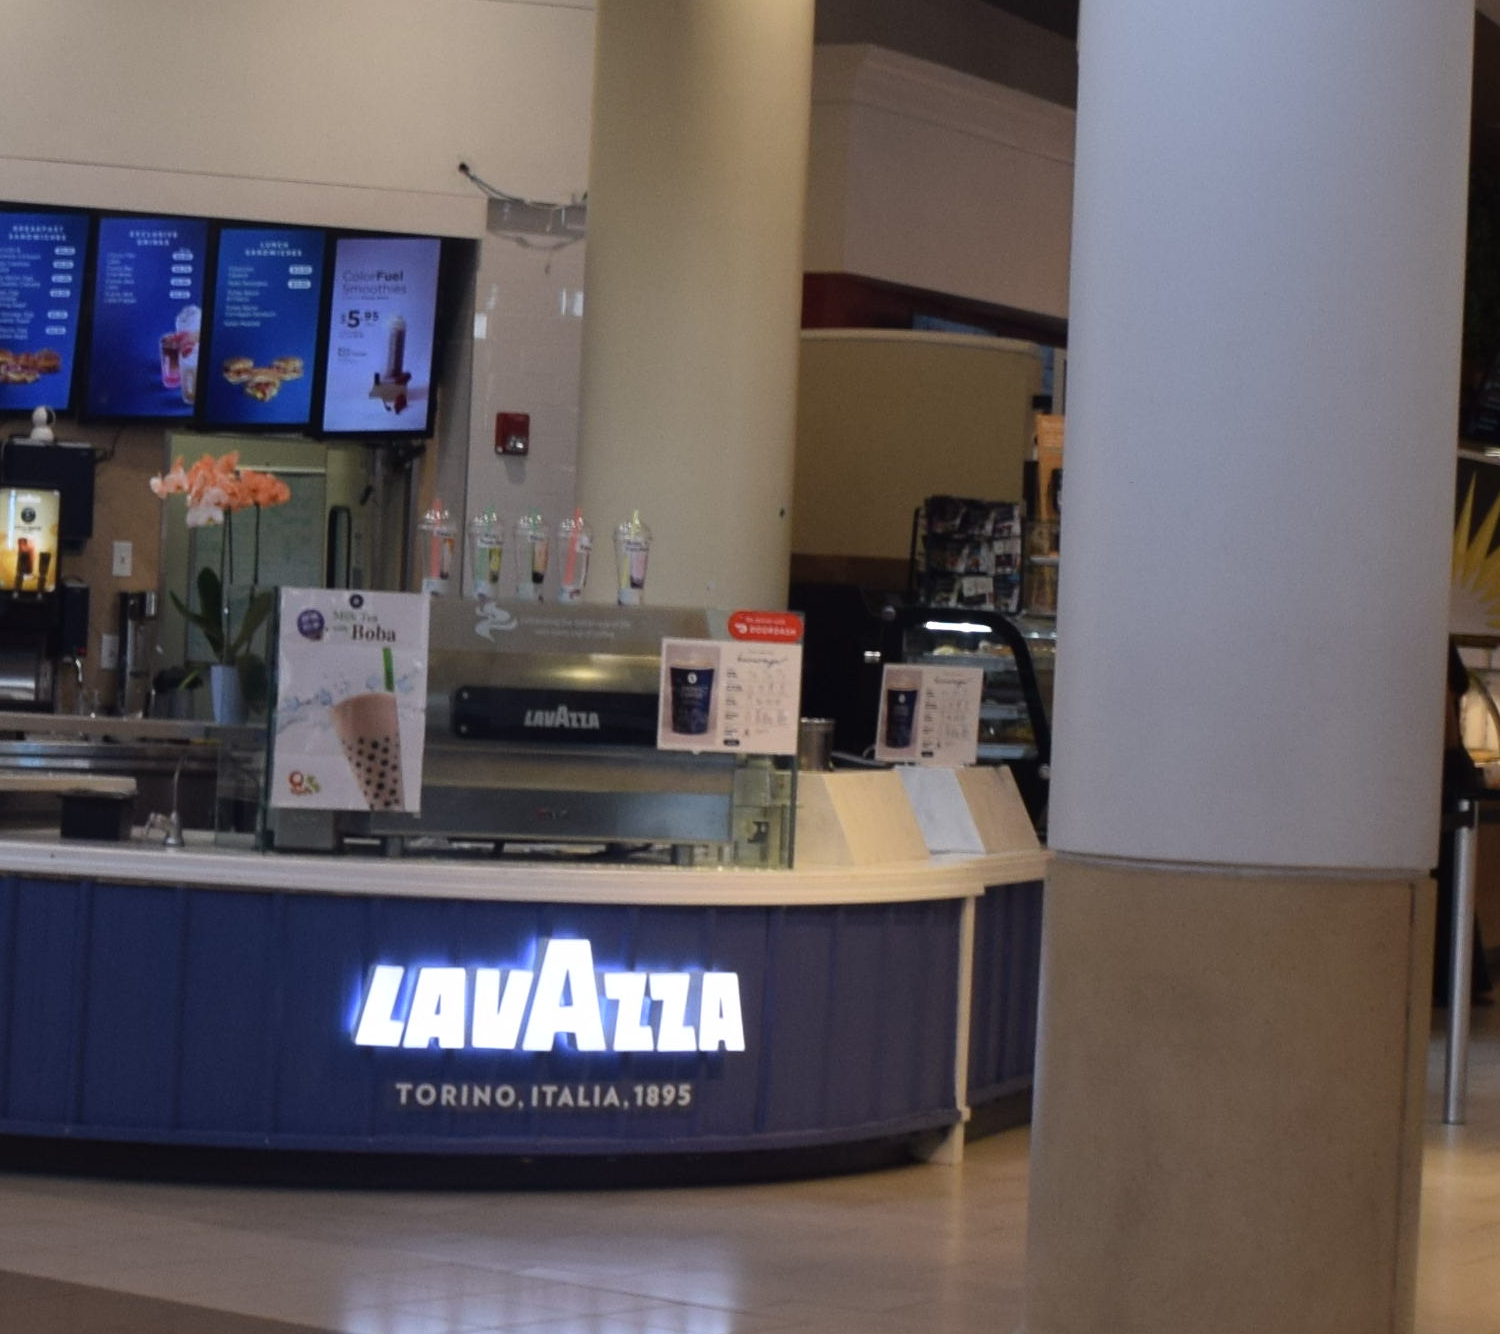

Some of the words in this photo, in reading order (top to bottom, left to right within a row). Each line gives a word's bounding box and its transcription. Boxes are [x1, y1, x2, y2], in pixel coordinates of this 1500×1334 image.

[351, 623, 397, 644] Boba
[523, 703, 600, 731] LAVAZZA
[353, 938, 746, 1053] LAVAZZA
[396, 1082, 525, 1111] TORINO,
[530, 1083, 630, 1110] ITALIA,
[634, 1084, 693, 1108] 1895
